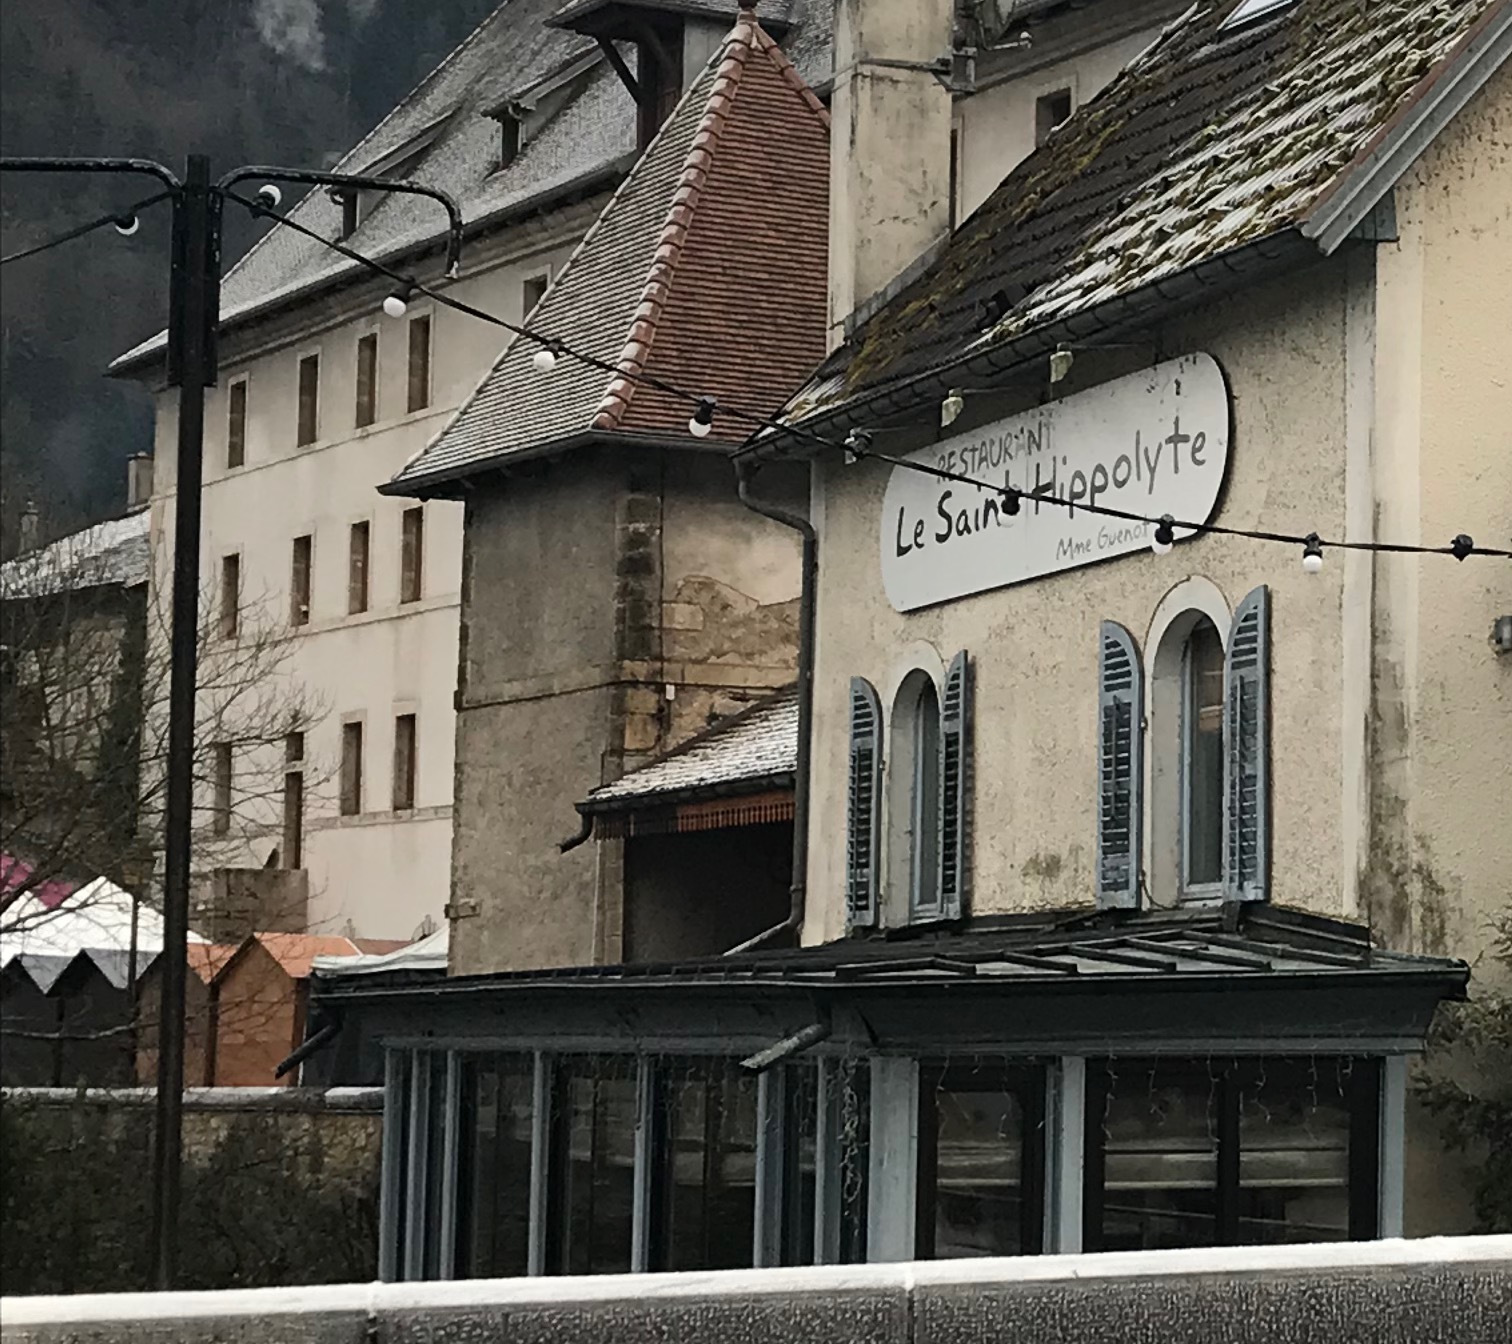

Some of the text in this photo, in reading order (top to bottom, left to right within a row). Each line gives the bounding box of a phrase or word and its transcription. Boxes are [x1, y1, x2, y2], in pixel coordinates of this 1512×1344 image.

[937, 418, 1055, 484] RESTAURANT
[896, 505, 925, 558] Le
[1031, 415, 1206, 519] Hippolyte
[1056, 514, 1150, 561] Mme Guenot
